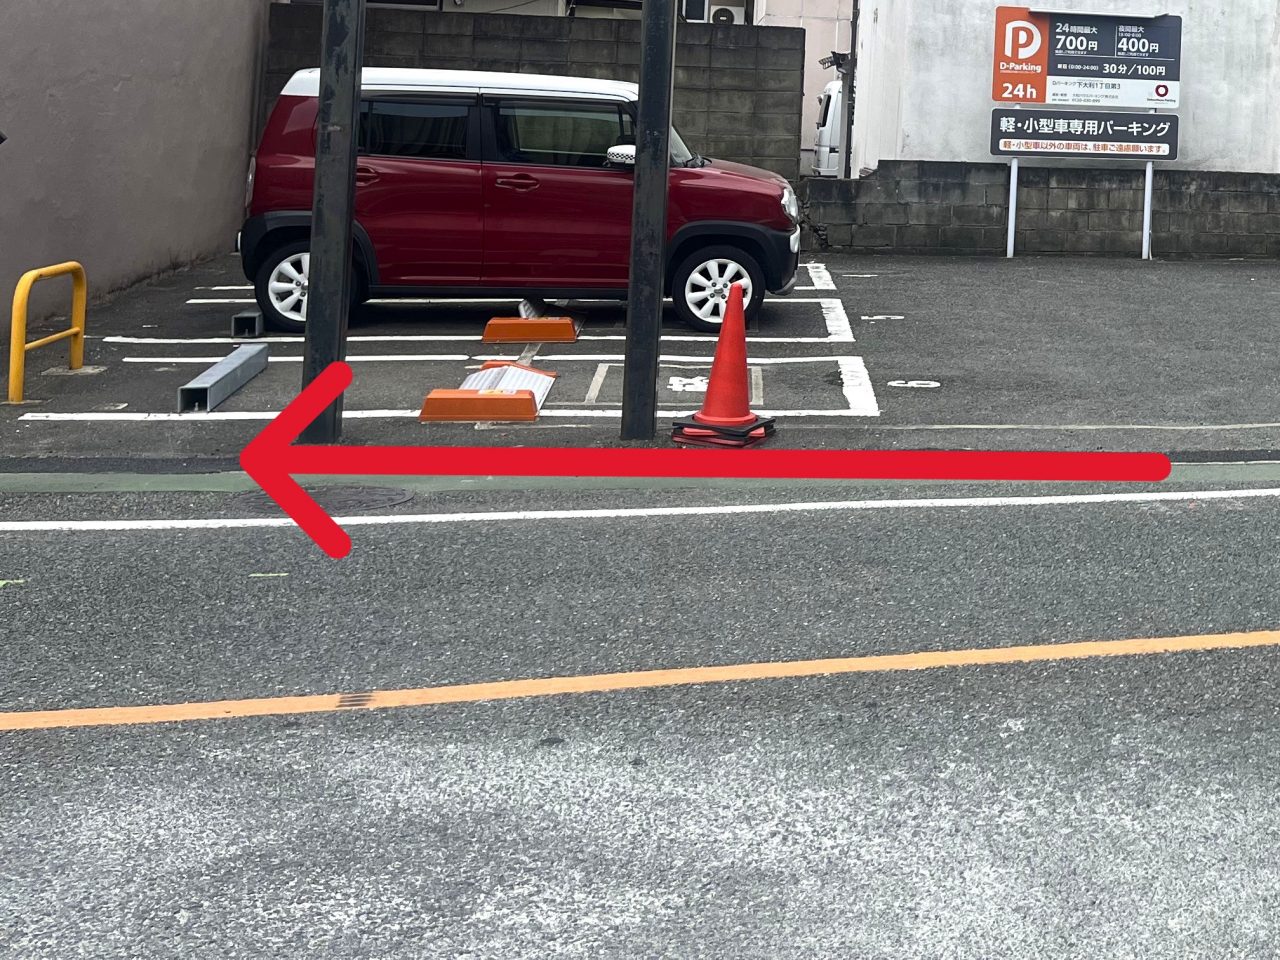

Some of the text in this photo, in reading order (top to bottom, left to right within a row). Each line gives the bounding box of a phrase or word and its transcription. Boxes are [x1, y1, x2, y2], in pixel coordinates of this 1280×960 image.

[1055, 23, 1098, 34] 24時間最大
[1055, 36, 1098, 51] 700円
[1117, 37, 1159, 53] 400円
[1000, 62, 1041, 73] D-Parking
[1002, 82, 1037, 99] 24h
[1000, 117, 1171, 137] 軽・小型車専用パーキング
